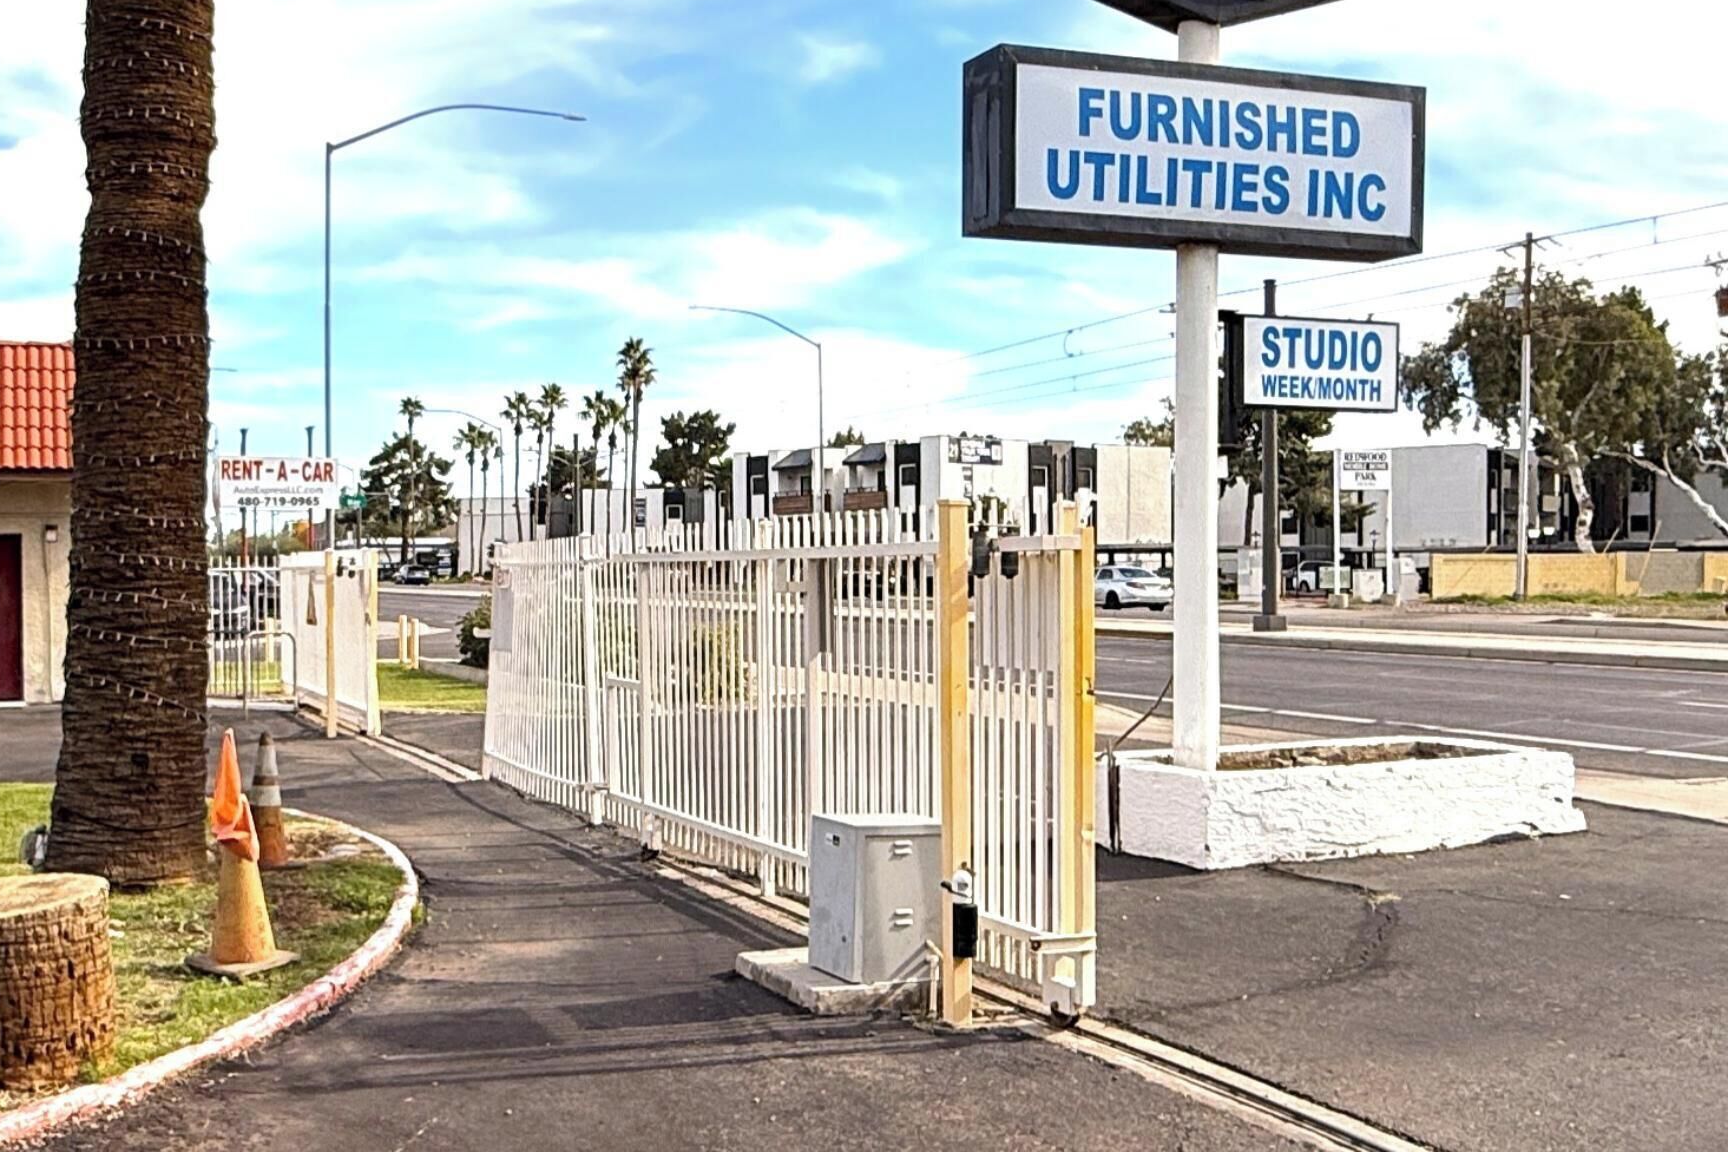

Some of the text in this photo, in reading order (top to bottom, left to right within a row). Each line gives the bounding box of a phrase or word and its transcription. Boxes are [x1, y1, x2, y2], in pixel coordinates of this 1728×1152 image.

[1077, 86, 1362, 159] FURNISHED
[1046, 148, 1387, 222] UTILITIES INC
[1260, 325, 1384, 373] STUDIO
[1260, 375, 1383, 403] WEEK/MONTH
[237, 496, 321, 507] 480-719-0965
